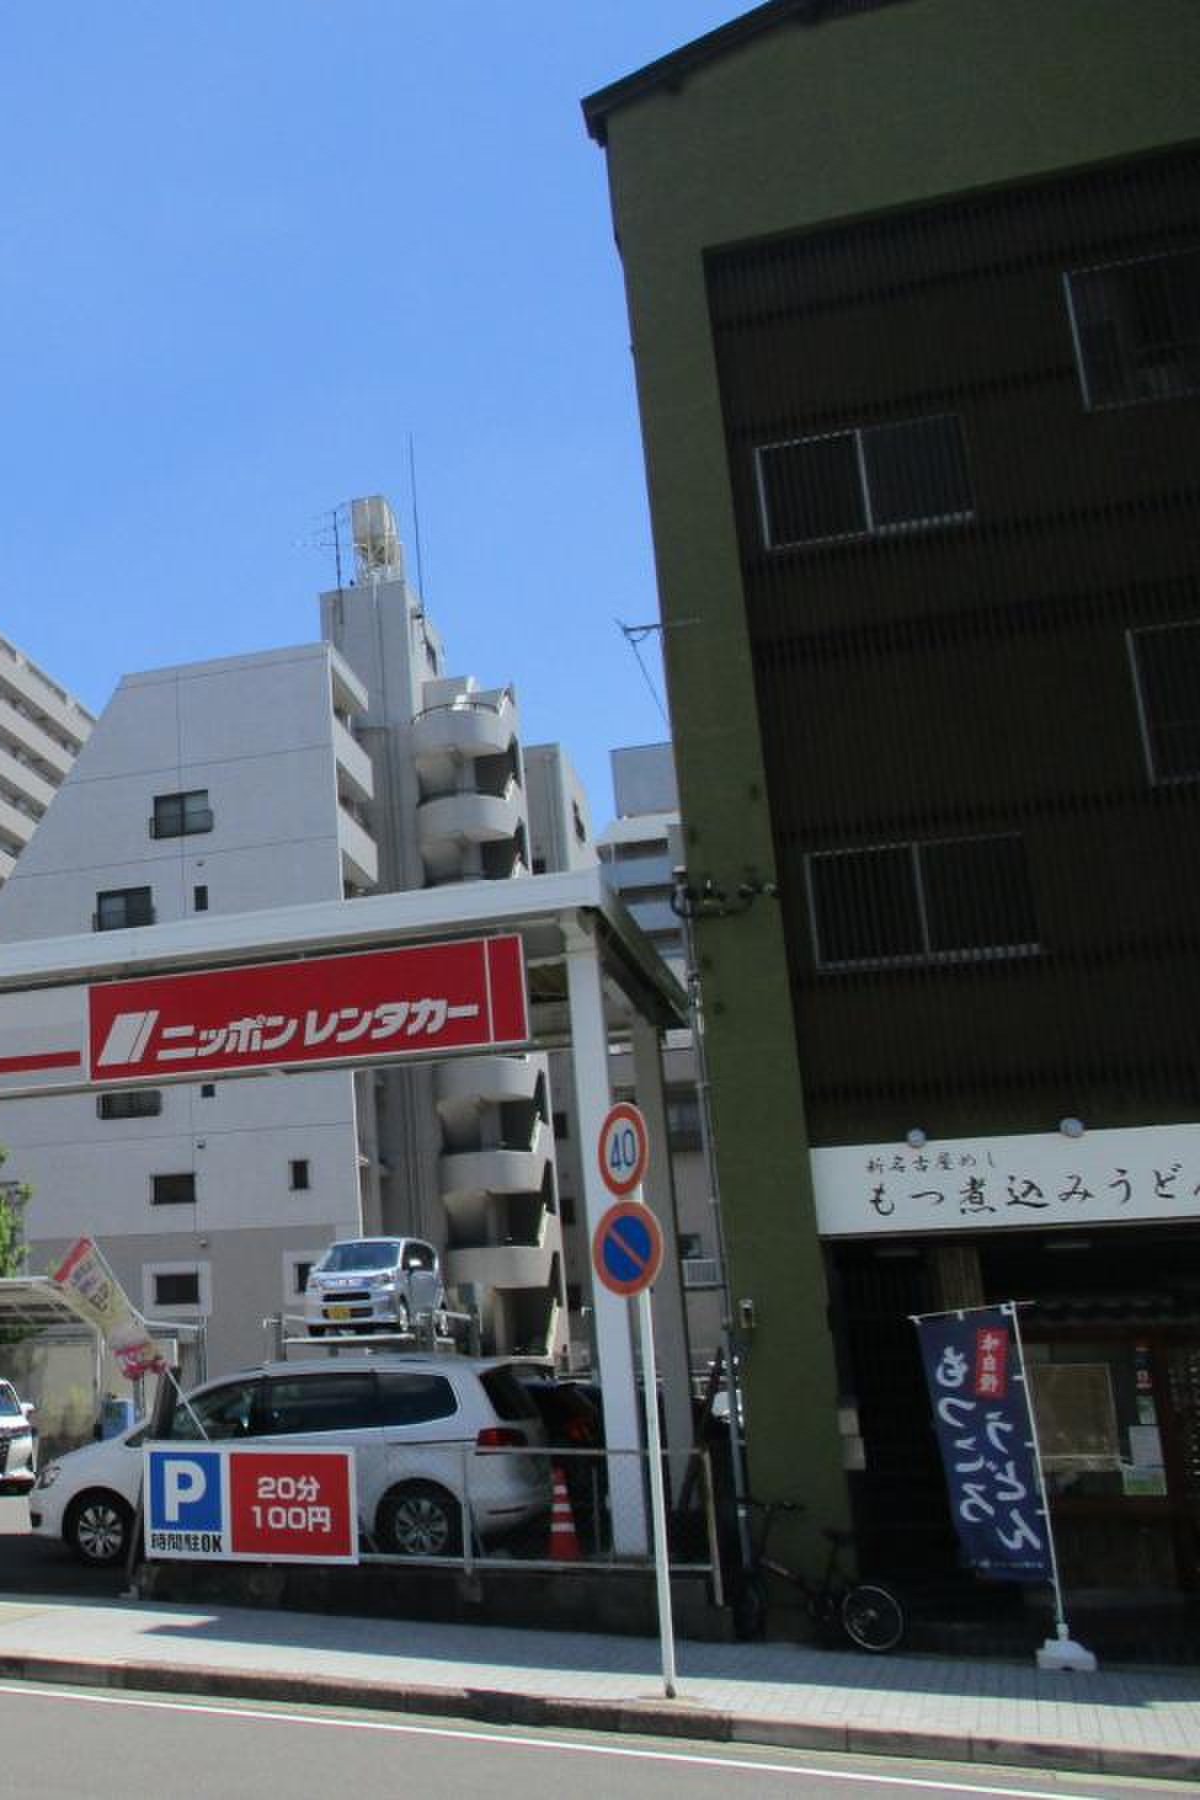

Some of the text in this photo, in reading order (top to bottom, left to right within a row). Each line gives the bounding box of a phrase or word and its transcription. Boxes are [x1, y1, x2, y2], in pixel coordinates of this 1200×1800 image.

[156, 998, 479, 1061] ニッポンレンタカー
[611, 1129, 636, 1170] 40
[869, 1163, 1200, 1217] もつ煮込みうど
[164, 1460, 207, 1522] P
[257, 1476, 321, 1502] 20分
[252, 1506, 331, 1533] 100円
